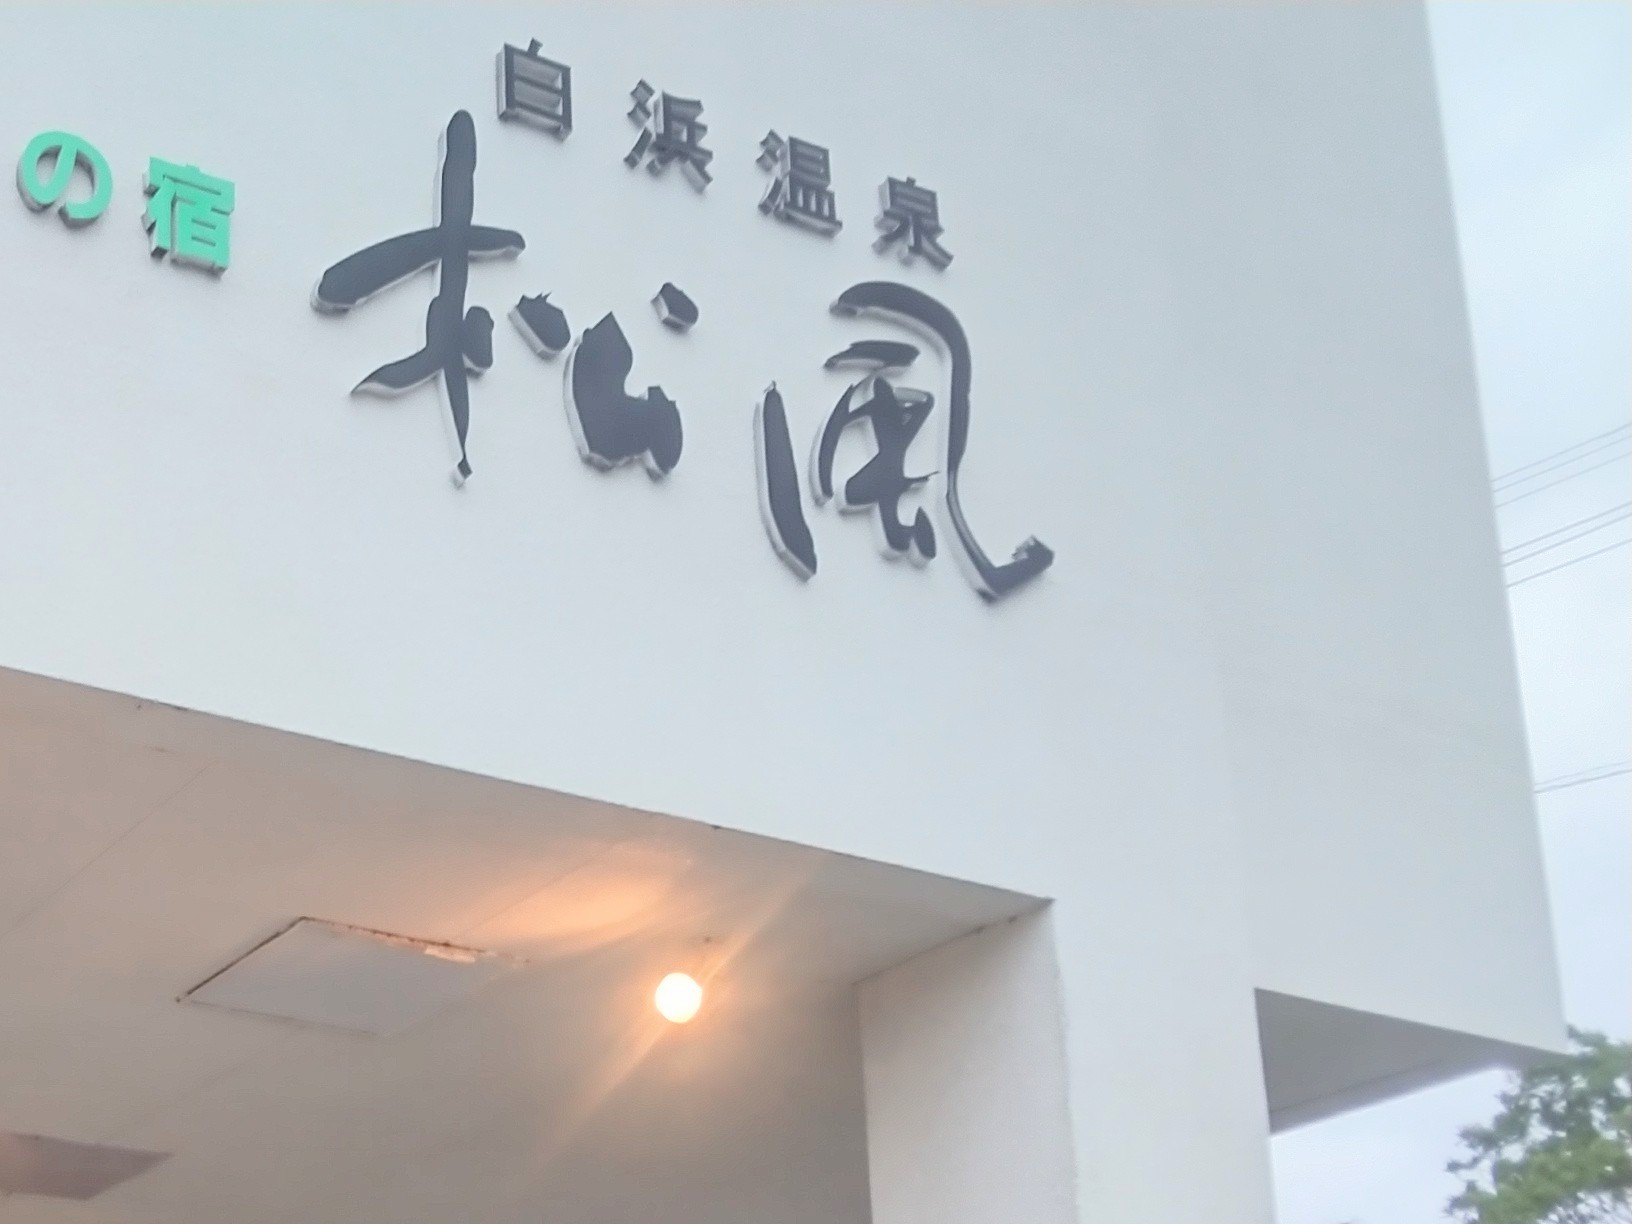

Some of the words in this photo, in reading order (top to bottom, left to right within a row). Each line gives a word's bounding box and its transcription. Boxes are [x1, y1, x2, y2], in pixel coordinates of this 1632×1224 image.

[494, 38, 954, 268] 白浜温泉
[310, 108, 1056, 602] 松風
